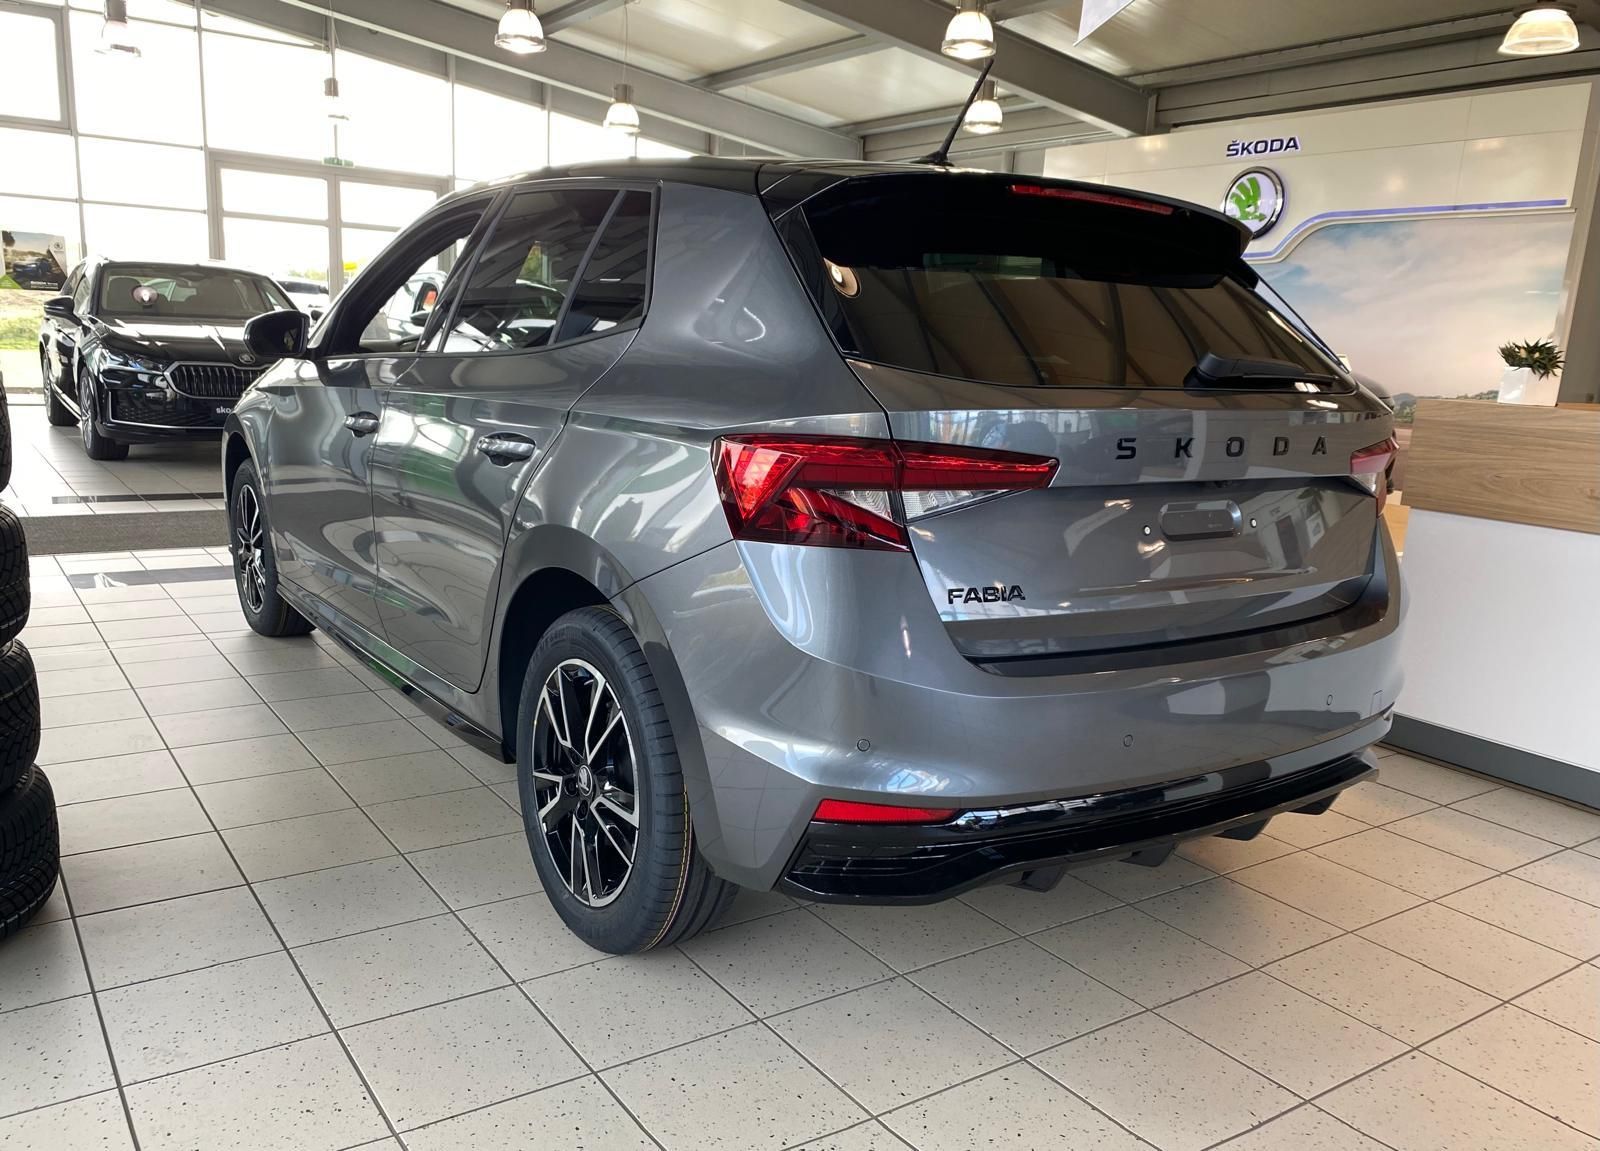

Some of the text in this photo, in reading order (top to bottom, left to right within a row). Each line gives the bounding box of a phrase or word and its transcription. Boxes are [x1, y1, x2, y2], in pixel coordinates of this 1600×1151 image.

[1226, 137, 1299, 157] ŠKODA
[215, 405, 232, 414] sko
[1115, 436, 1328, 460] SKODA
[947, 585, 1026, 604] FABIA
